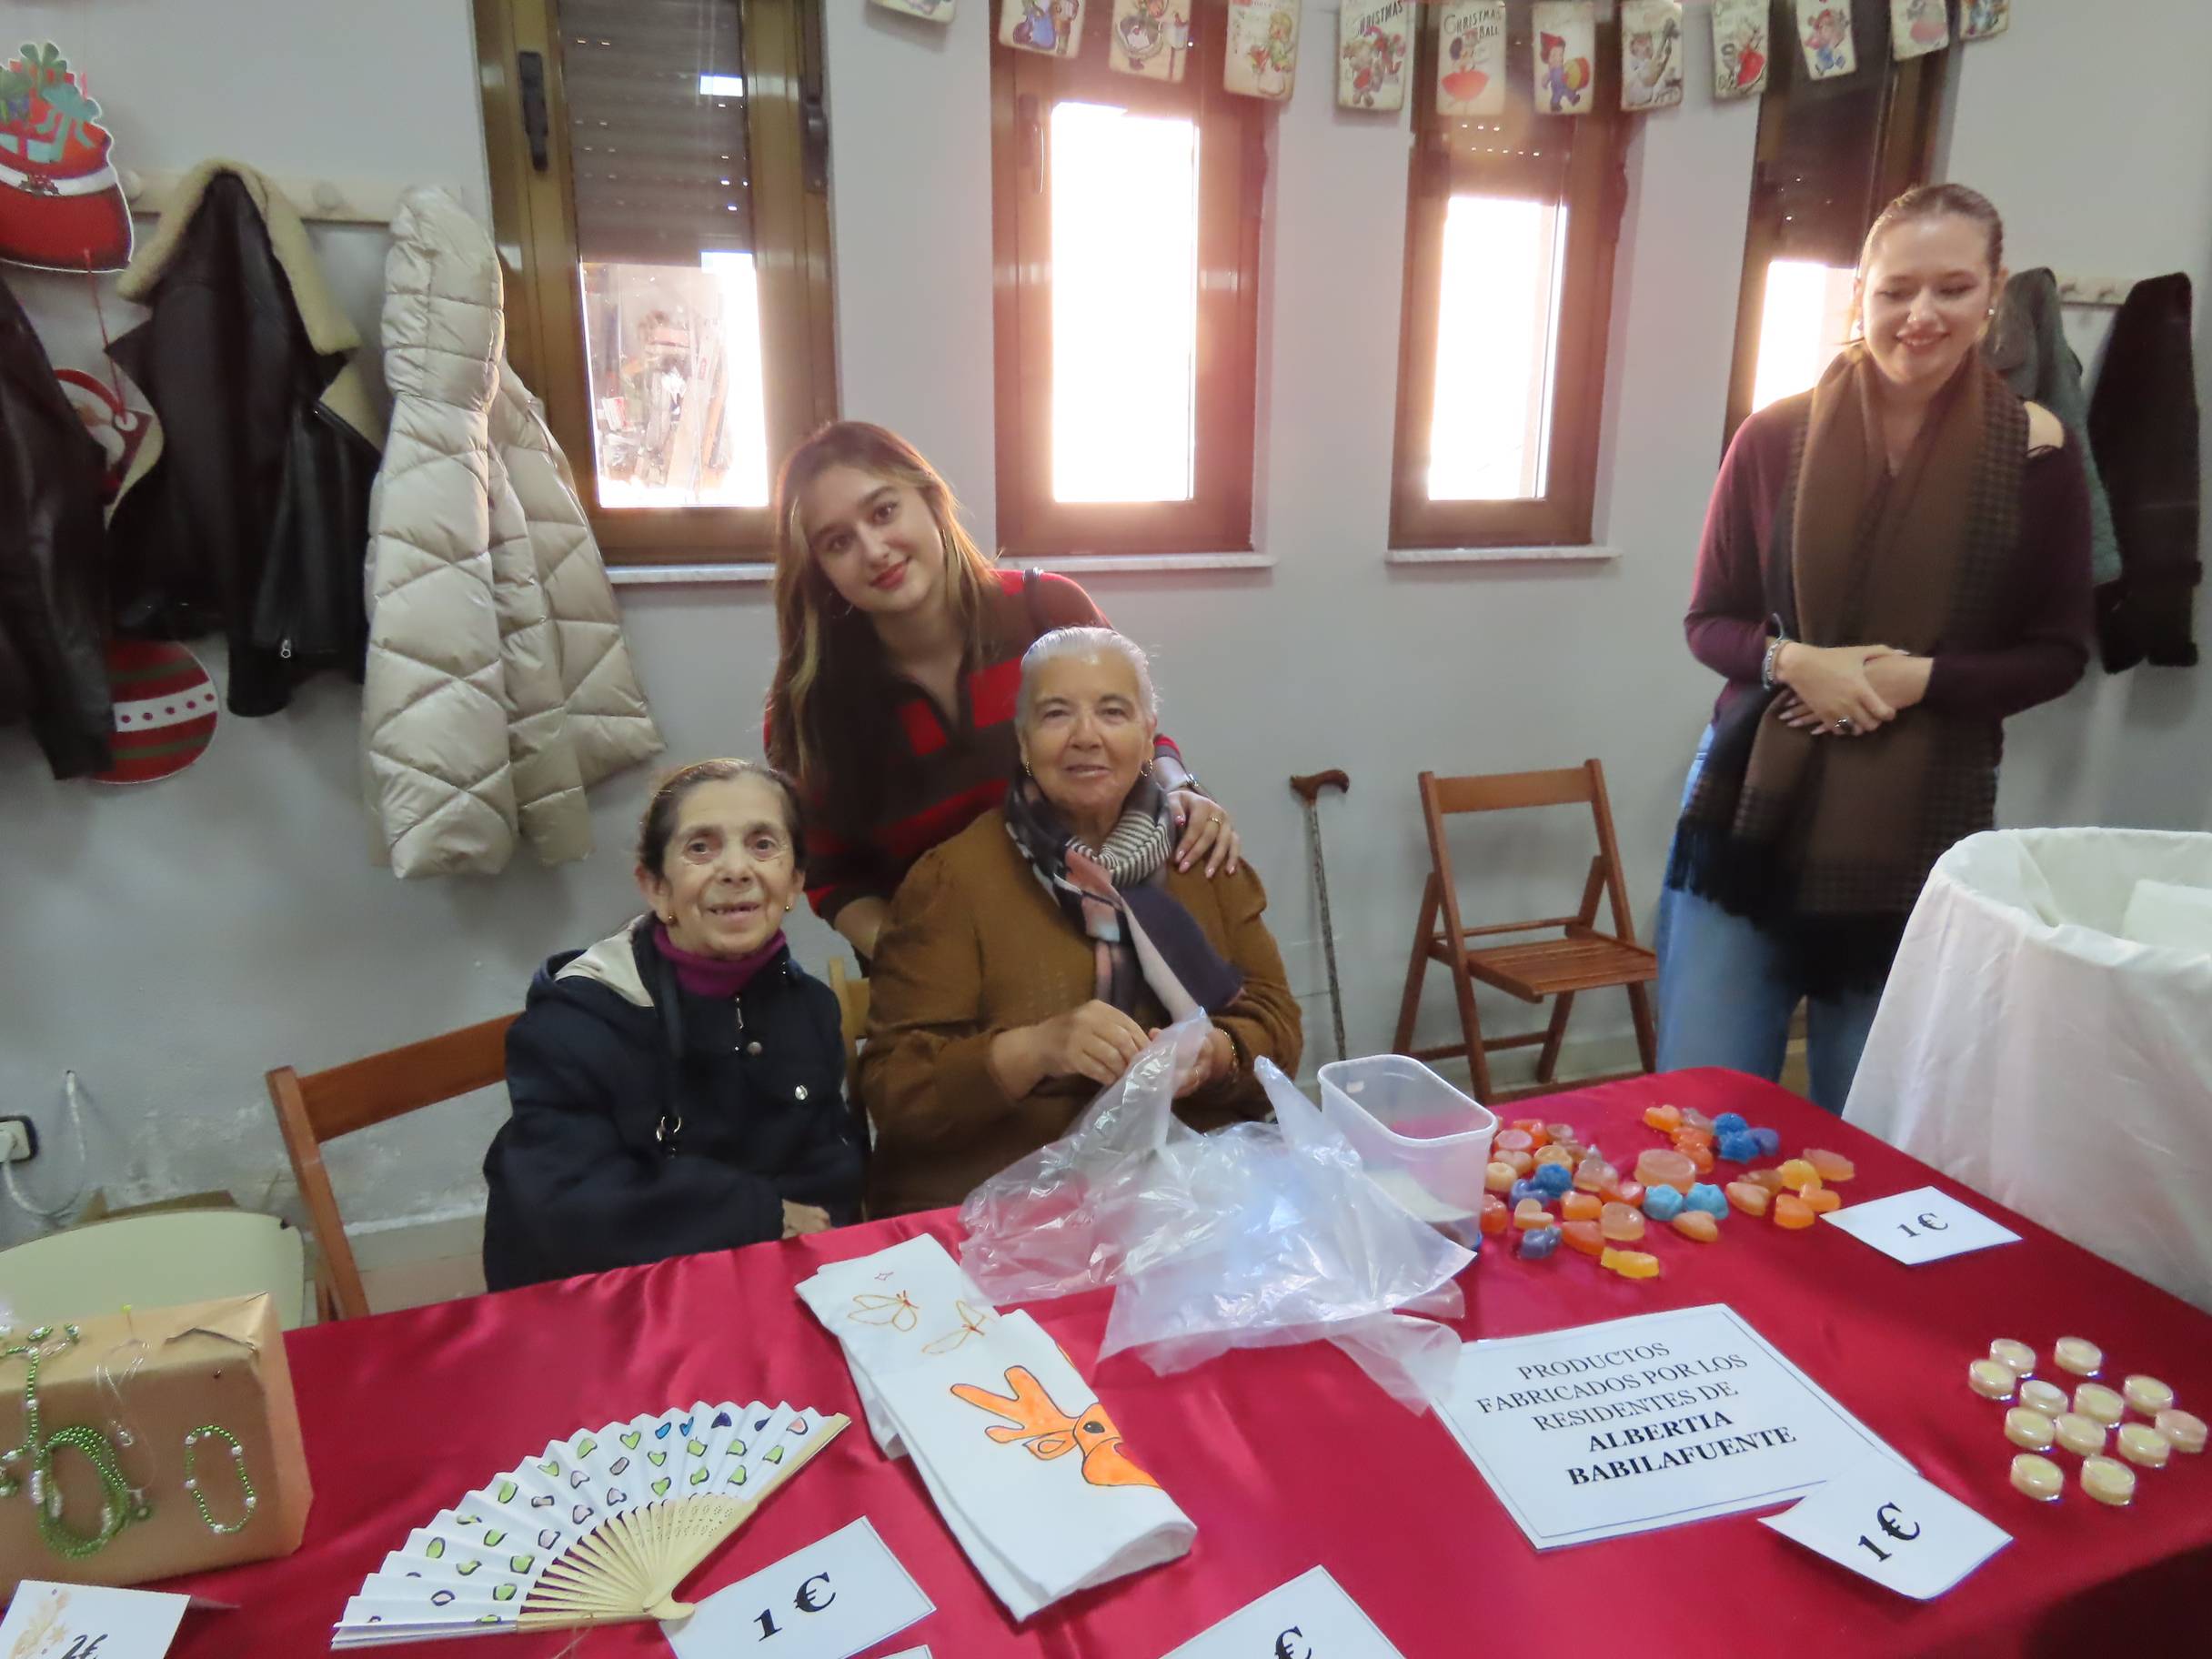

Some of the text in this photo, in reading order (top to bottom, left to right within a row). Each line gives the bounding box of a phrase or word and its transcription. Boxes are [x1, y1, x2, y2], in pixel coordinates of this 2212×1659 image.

[1476, 1353, 1748, 1413] FABRICADOS POR LOS
[1517, 1342, 1670, 1381] PRODUCTOS
[1532, 1381, 1739, 1431] RESIDENTES DE
[1566, 1426, 1797, 1486] BABILAFUENTE
[1588, 1411, 1734, 1453] ALBERTIA
